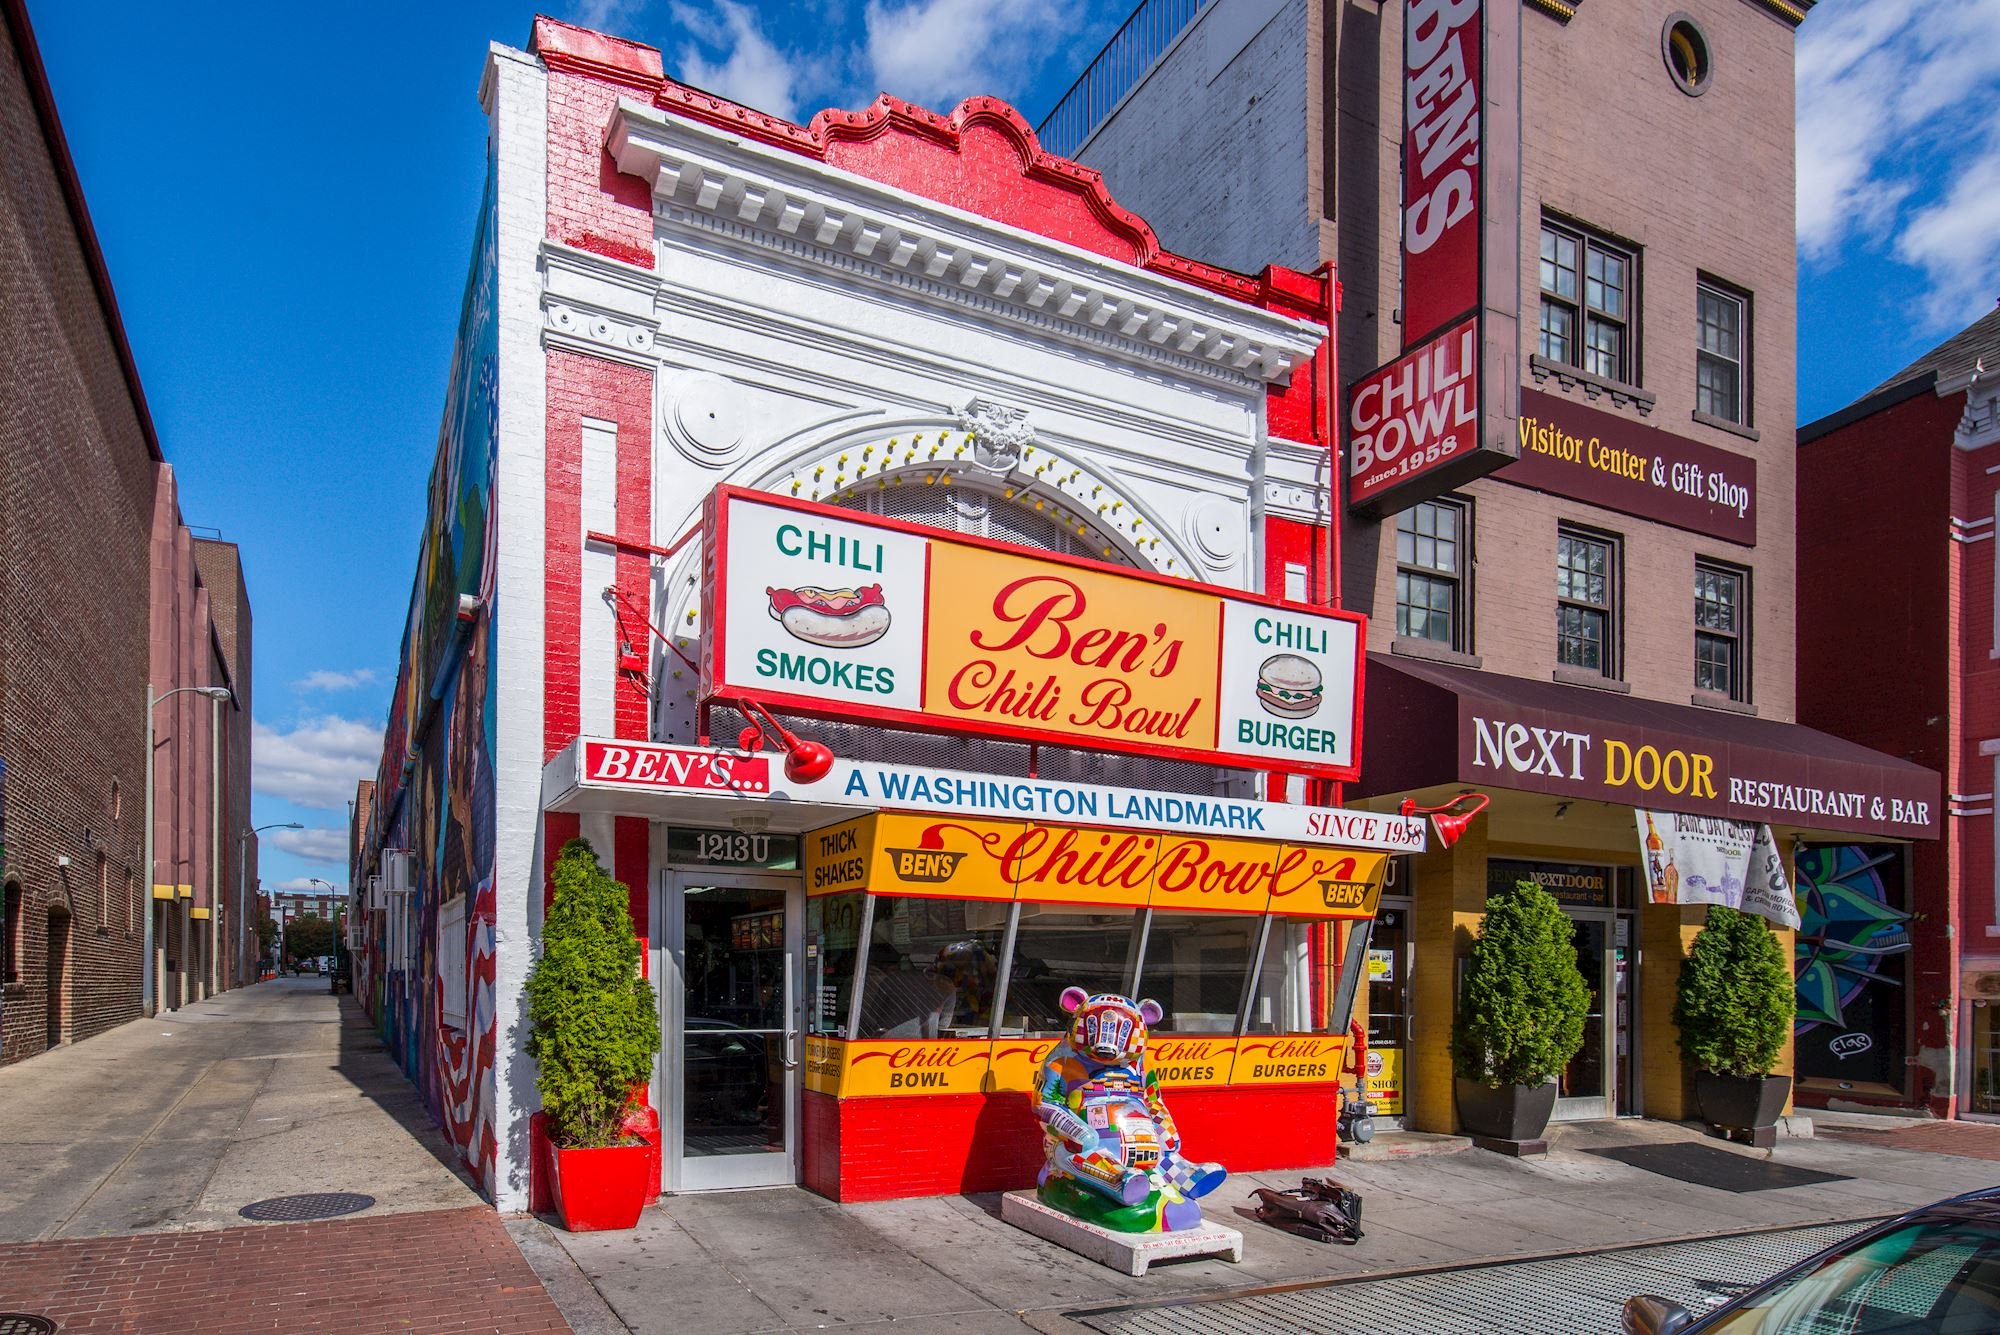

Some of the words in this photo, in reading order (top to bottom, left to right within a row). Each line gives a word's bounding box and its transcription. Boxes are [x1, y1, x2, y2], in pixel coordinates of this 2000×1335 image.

[1351, 329, 1473, 432] CHILI
[1351, 383, 1478, 477] BOWL
[1363, 466, 1398, 489] since
[1399, 434, 1458, 477] 1958
[1519, 416, 1584, 464] Visitor
[1588, 437, 1647, 482] Center
[1651, 456, 1667, 488] &
[1671, 462, 1704, 498] Gift
[1708, 472, 1749, 518] Shop
[776, 524, 884, 574] CHILI
[970, 576, 1183, 678] Ben's
[1254, 618, 1327, 654] CHILI
[756, 648, 895, 695] SMOKES
[948, 660, 1061, 721] Chili
[1069, 678, 1202, 739] Bowl
[1238, 719, 1336, 754] BURGER
[1603, 739, 1718, 799] DOOR
[1729, 777, 1866, 820] RESTAURANT
[1870, 797, 1888, 821] &
[1891, 798, 1930, 826] BAR
[844, 769, 870, 797] A
[878, 771, 1098, 818] WASHINGTON
[1108, 793, 1266, 831] LANDMARK
[1306, 812, 1379, 841] SINCE
[1381, 821, 1424, 846] 1958
[820, 828, 857, 857] THICK
[814, 858, 864, 888] SHAKES
[899, 852, 953, 878] BEN'S
[998, 827, 1156, 888] Chili
[1157, 840, 1309, 897] Bowl
[1326, 884, 1365, 904] BEN'S
[1772, 903, 1796, 916] ROYAL
[887, 1047, 961, 1068] Chili
[1154, 1041, 1212, 1061] Chili
[1267, 1040, 1321, 1058] Chili
[890, 1072, 949, 1088] BOWL
[1156, 1066, 1215, 1081] MOKES
[1252, 1063, 1327, 1077] BURGERS
[1372, 1080, 1398, 1089] SHOP
